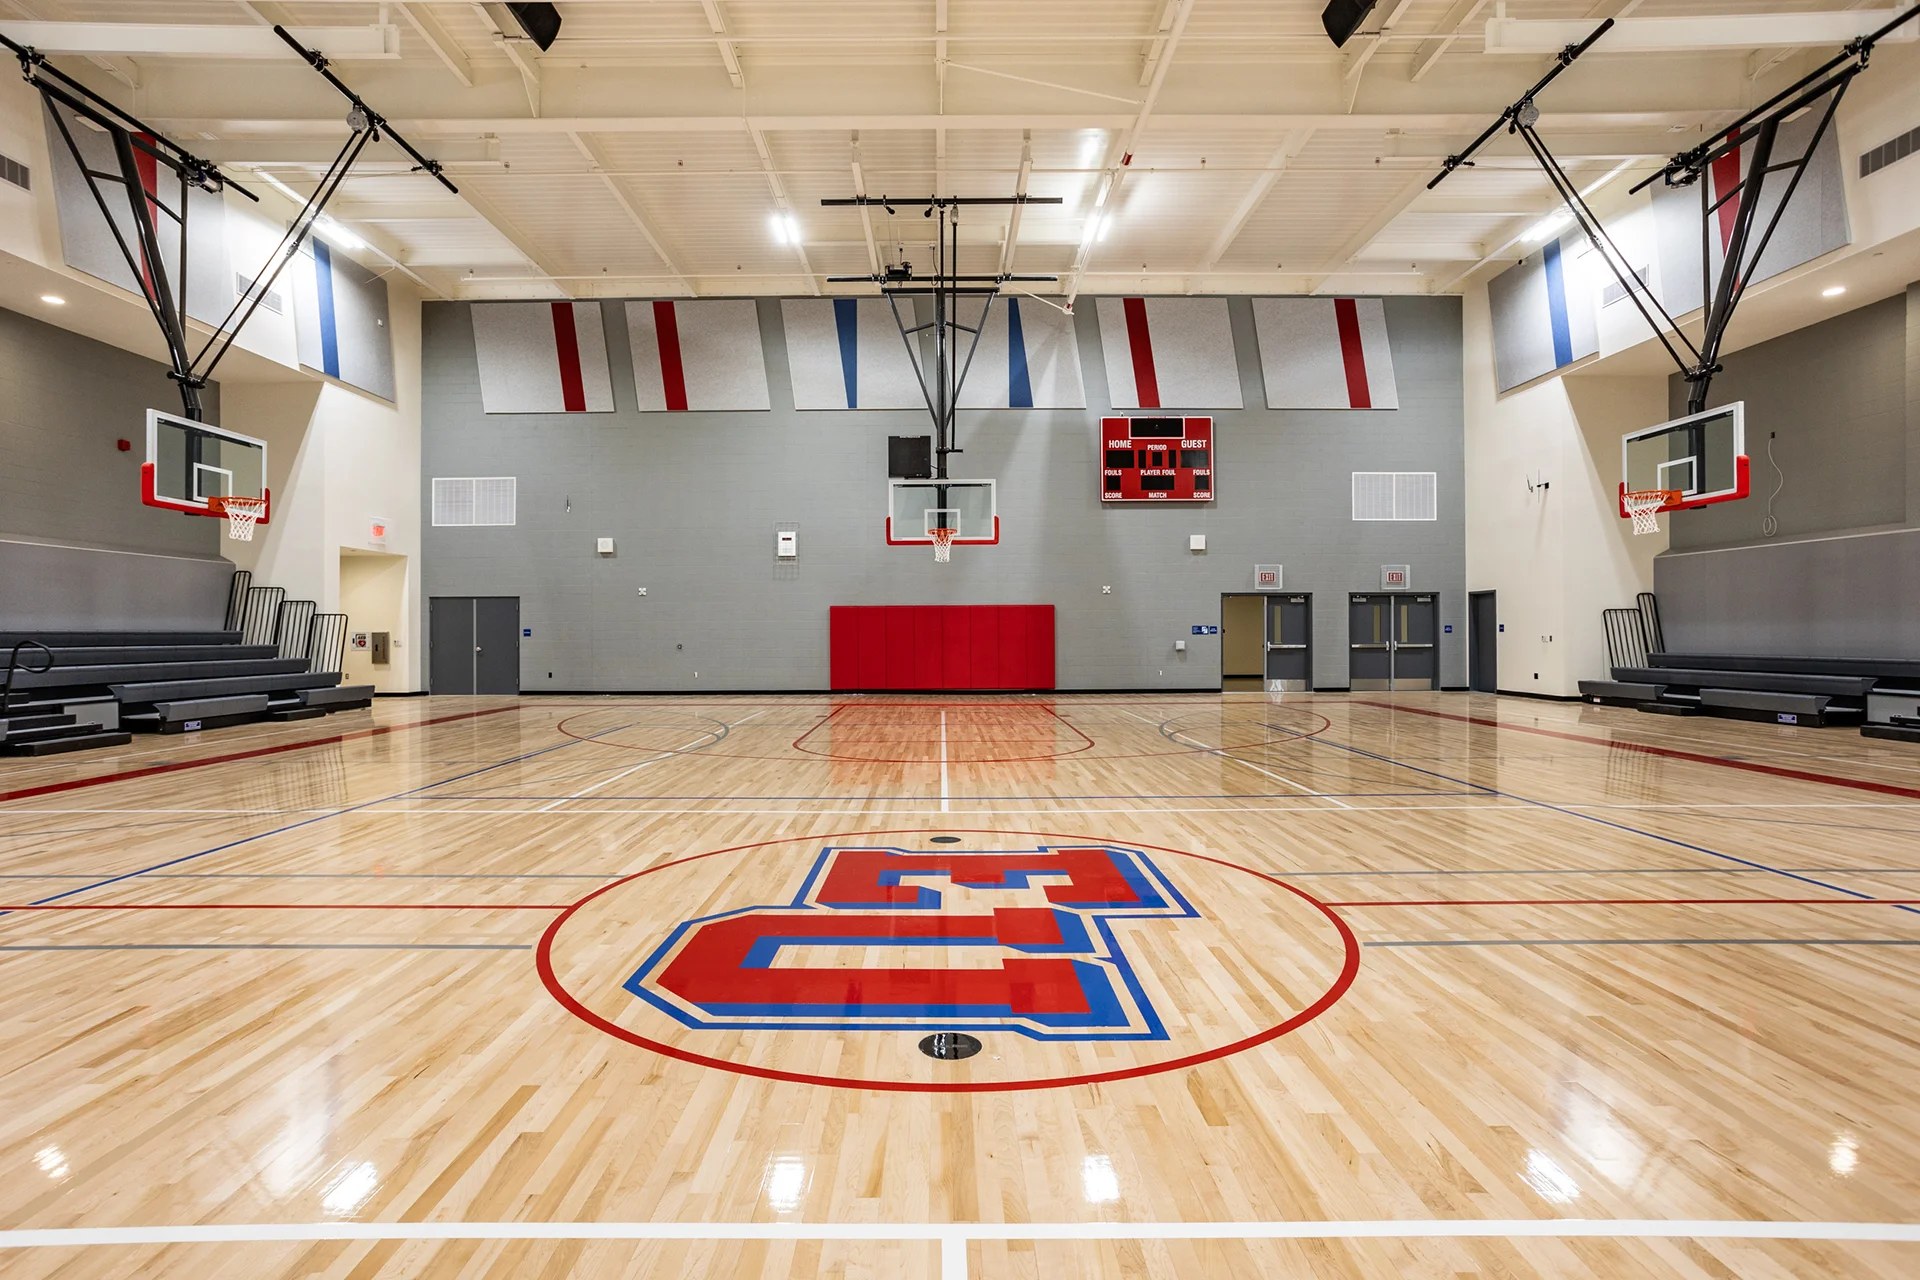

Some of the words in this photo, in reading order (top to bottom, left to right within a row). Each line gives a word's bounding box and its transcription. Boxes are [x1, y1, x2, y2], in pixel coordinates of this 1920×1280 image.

[1109, 440, 1132, 448] HOME
[1181, 440, 1207, 448] GUEST
[1389, 573, 1401, 581] EXIT
